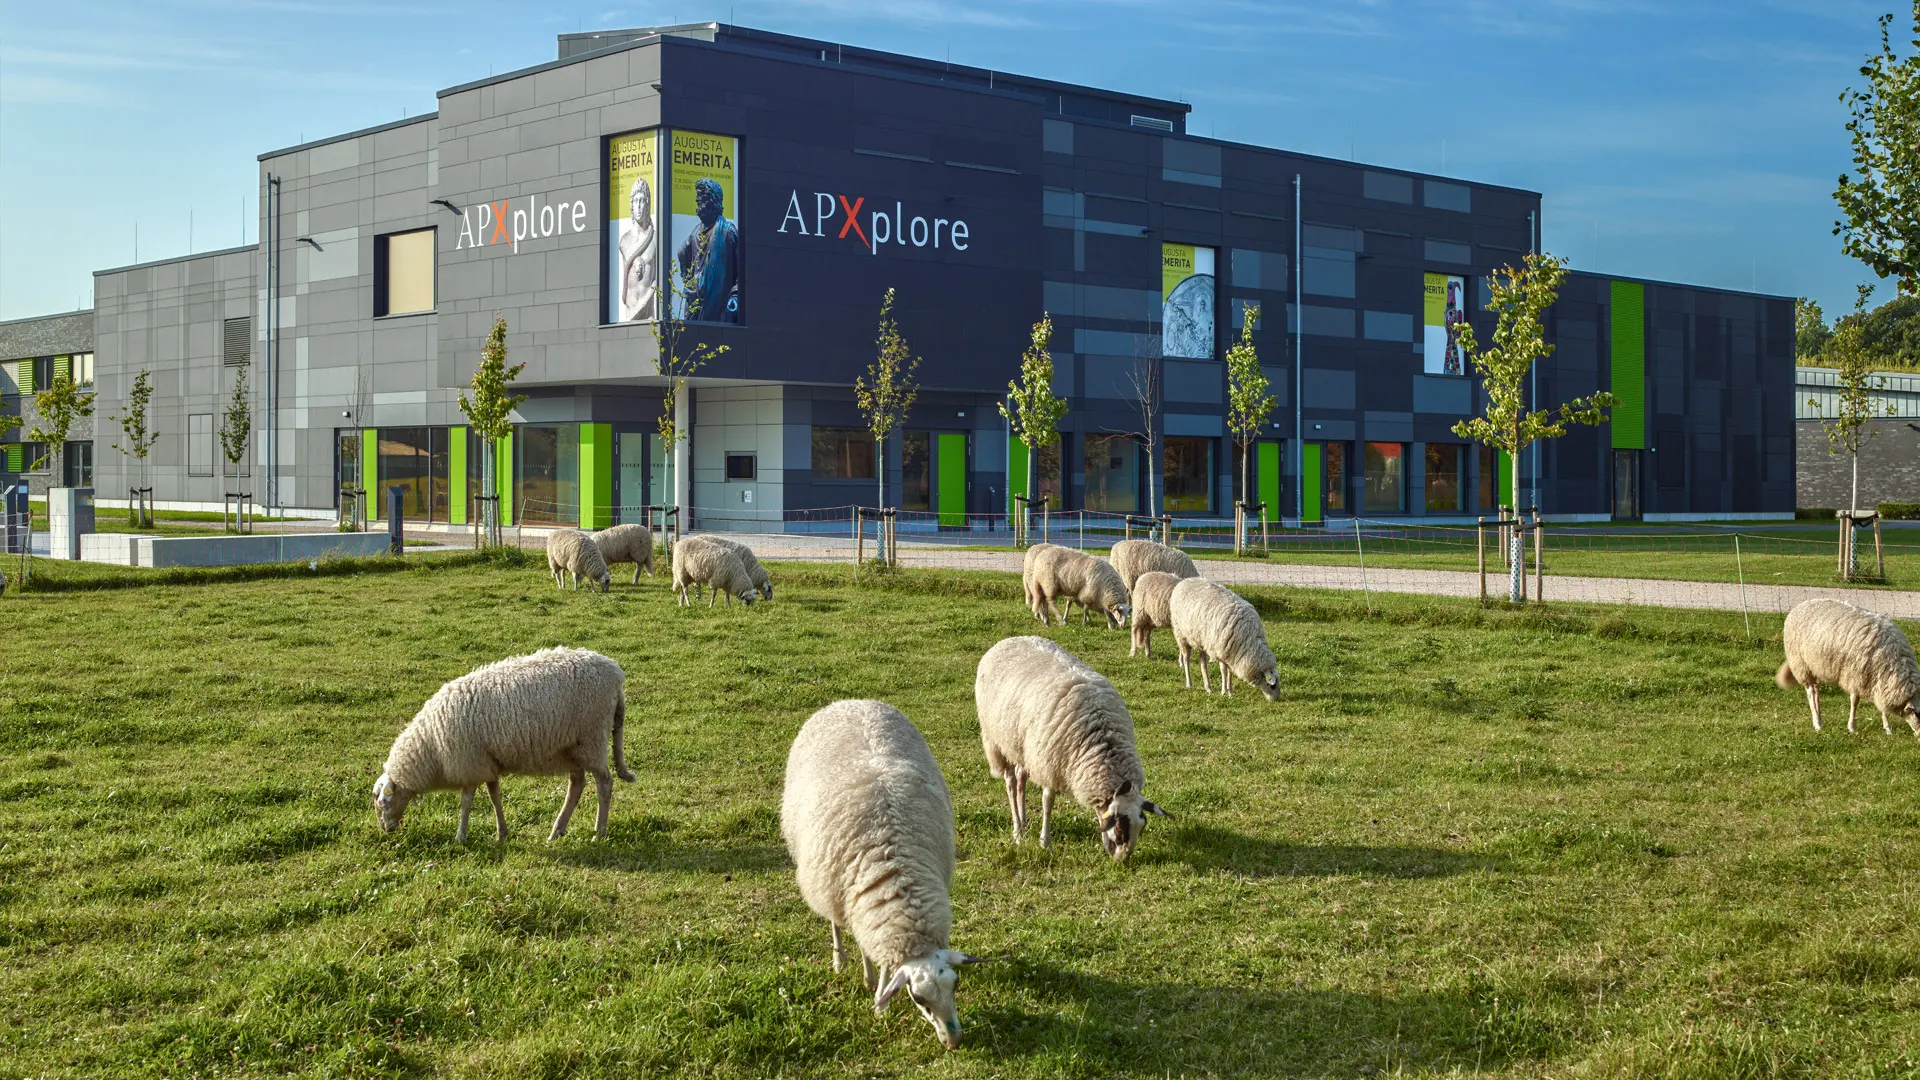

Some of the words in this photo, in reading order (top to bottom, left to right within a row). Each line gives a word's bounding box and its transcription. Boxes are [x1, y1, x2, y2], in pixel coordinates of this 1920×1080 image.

[612, 139, 647, 155] AUGUSTA
[674, 136, 723, 152] AUGUSTA
[611, 152, 653, 171] EMERITA
[674, 150, 732, 170] EMERITA
[456, 195, 587, 254] APXplore
[777, 189, 969, 255] APXplore
[1162, 248, 1186, 257] UGUSTA
